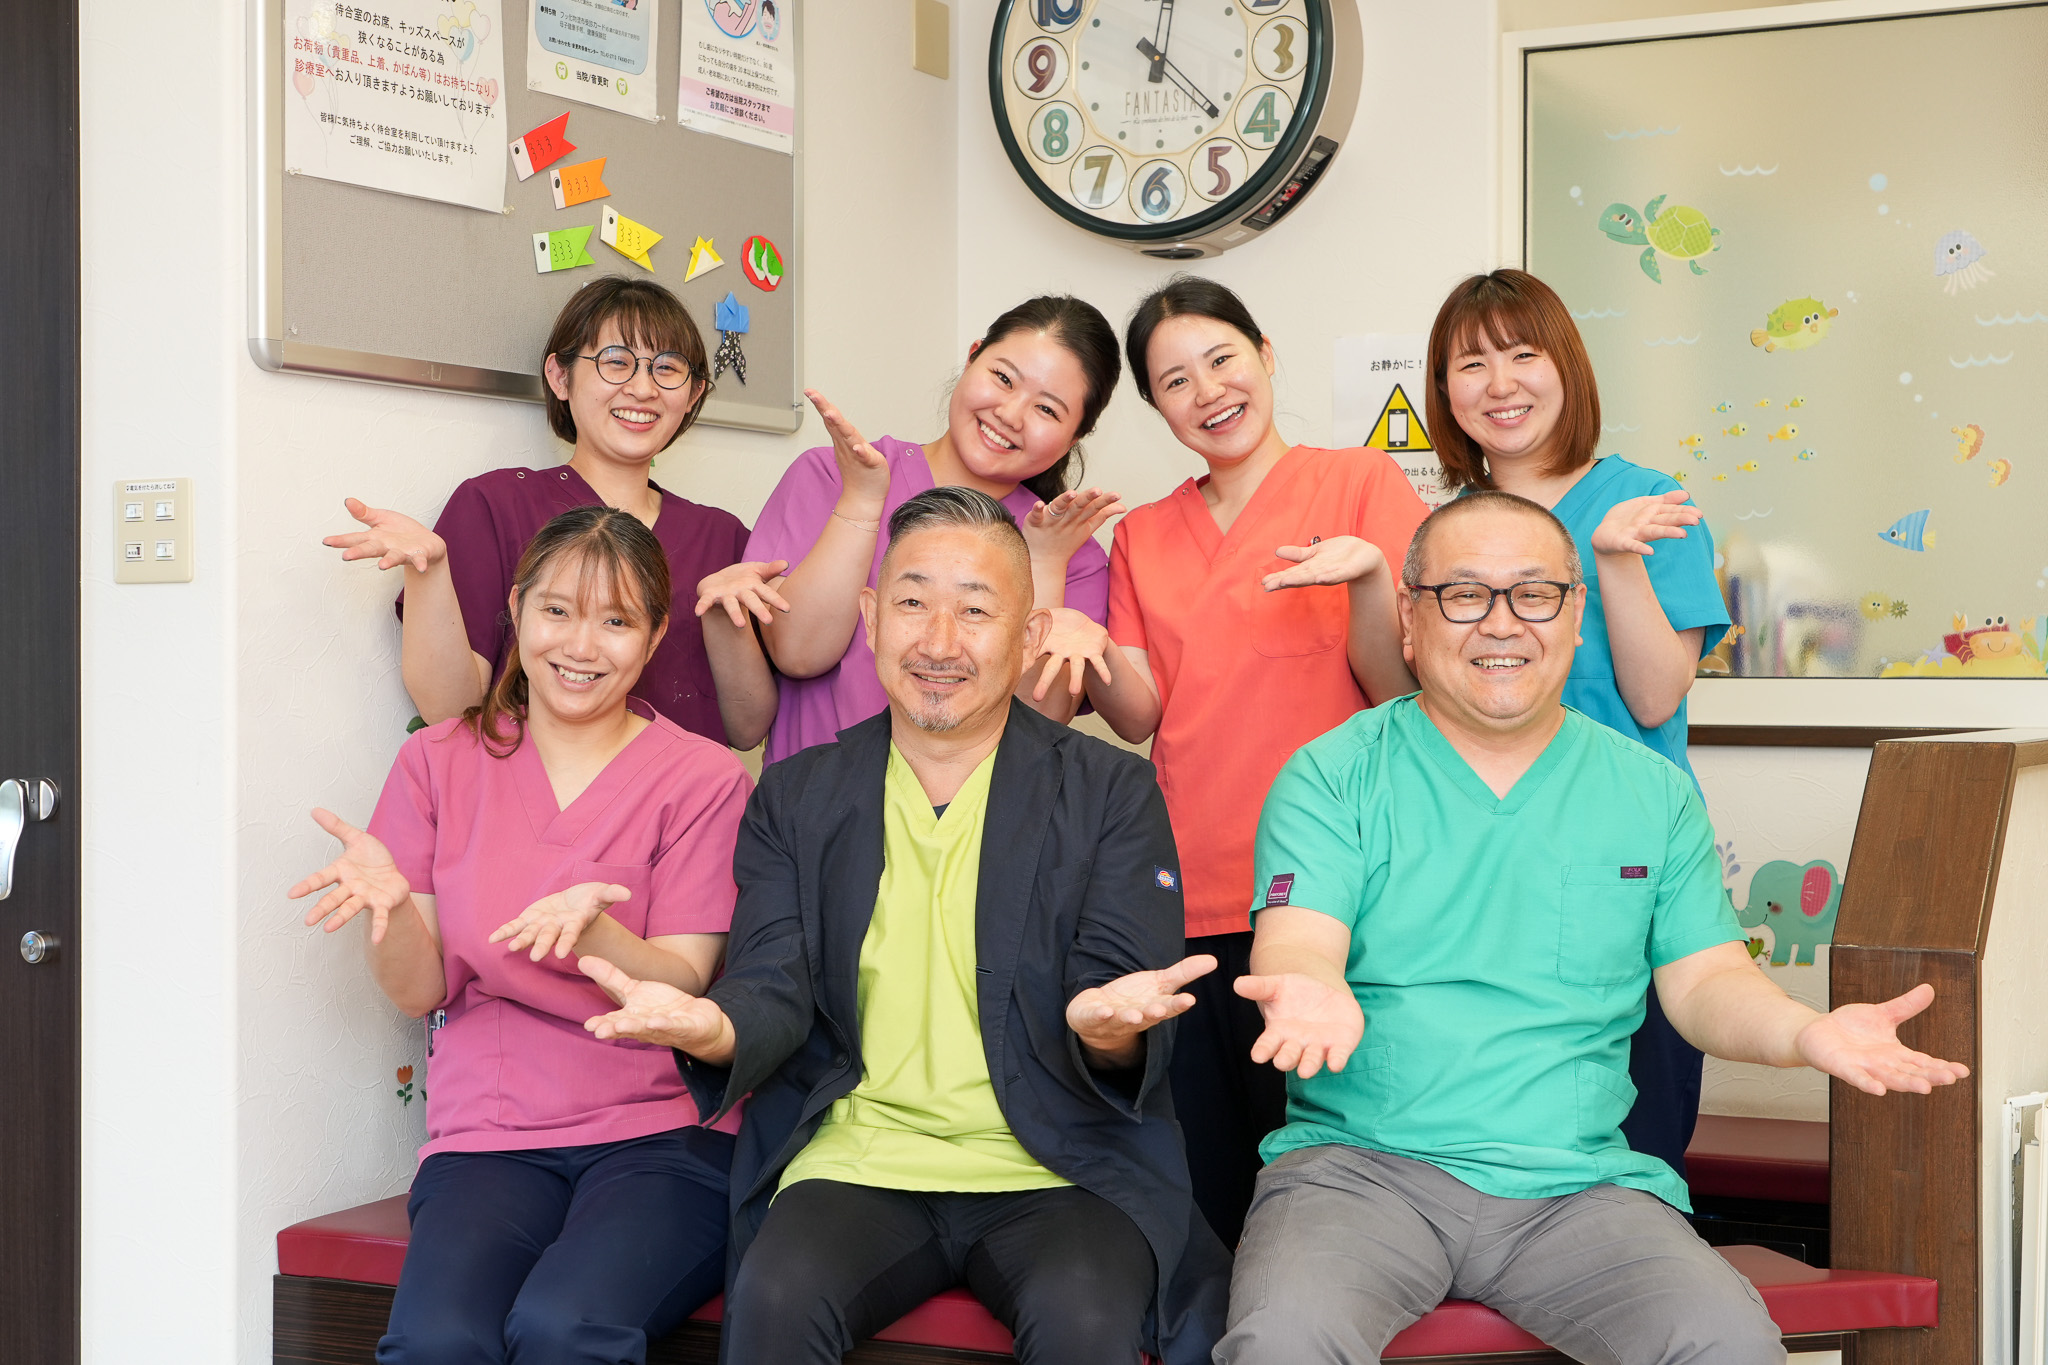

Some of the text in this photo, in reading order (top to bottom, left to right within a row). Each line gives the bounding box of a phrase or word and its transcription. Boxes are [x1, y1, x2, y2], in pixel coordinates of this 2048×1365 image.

[358, 30, 445, 65] 狭くなることがある為
[1028, 44, 1057, 93] 9
[1273, 23, 1294, 74] 3
[1125, 88, 1197, 116] FANTASIA
[1242, 91, 1281, 142] 4
[1042, 108, 1070, 158] 8
[1084, 154, 1114, 204] 7
[1141, 166, 1173, 216] 6
[1207, 146, 1233, 196] 5
[1371, 360, 1422, 371] お静かに！
